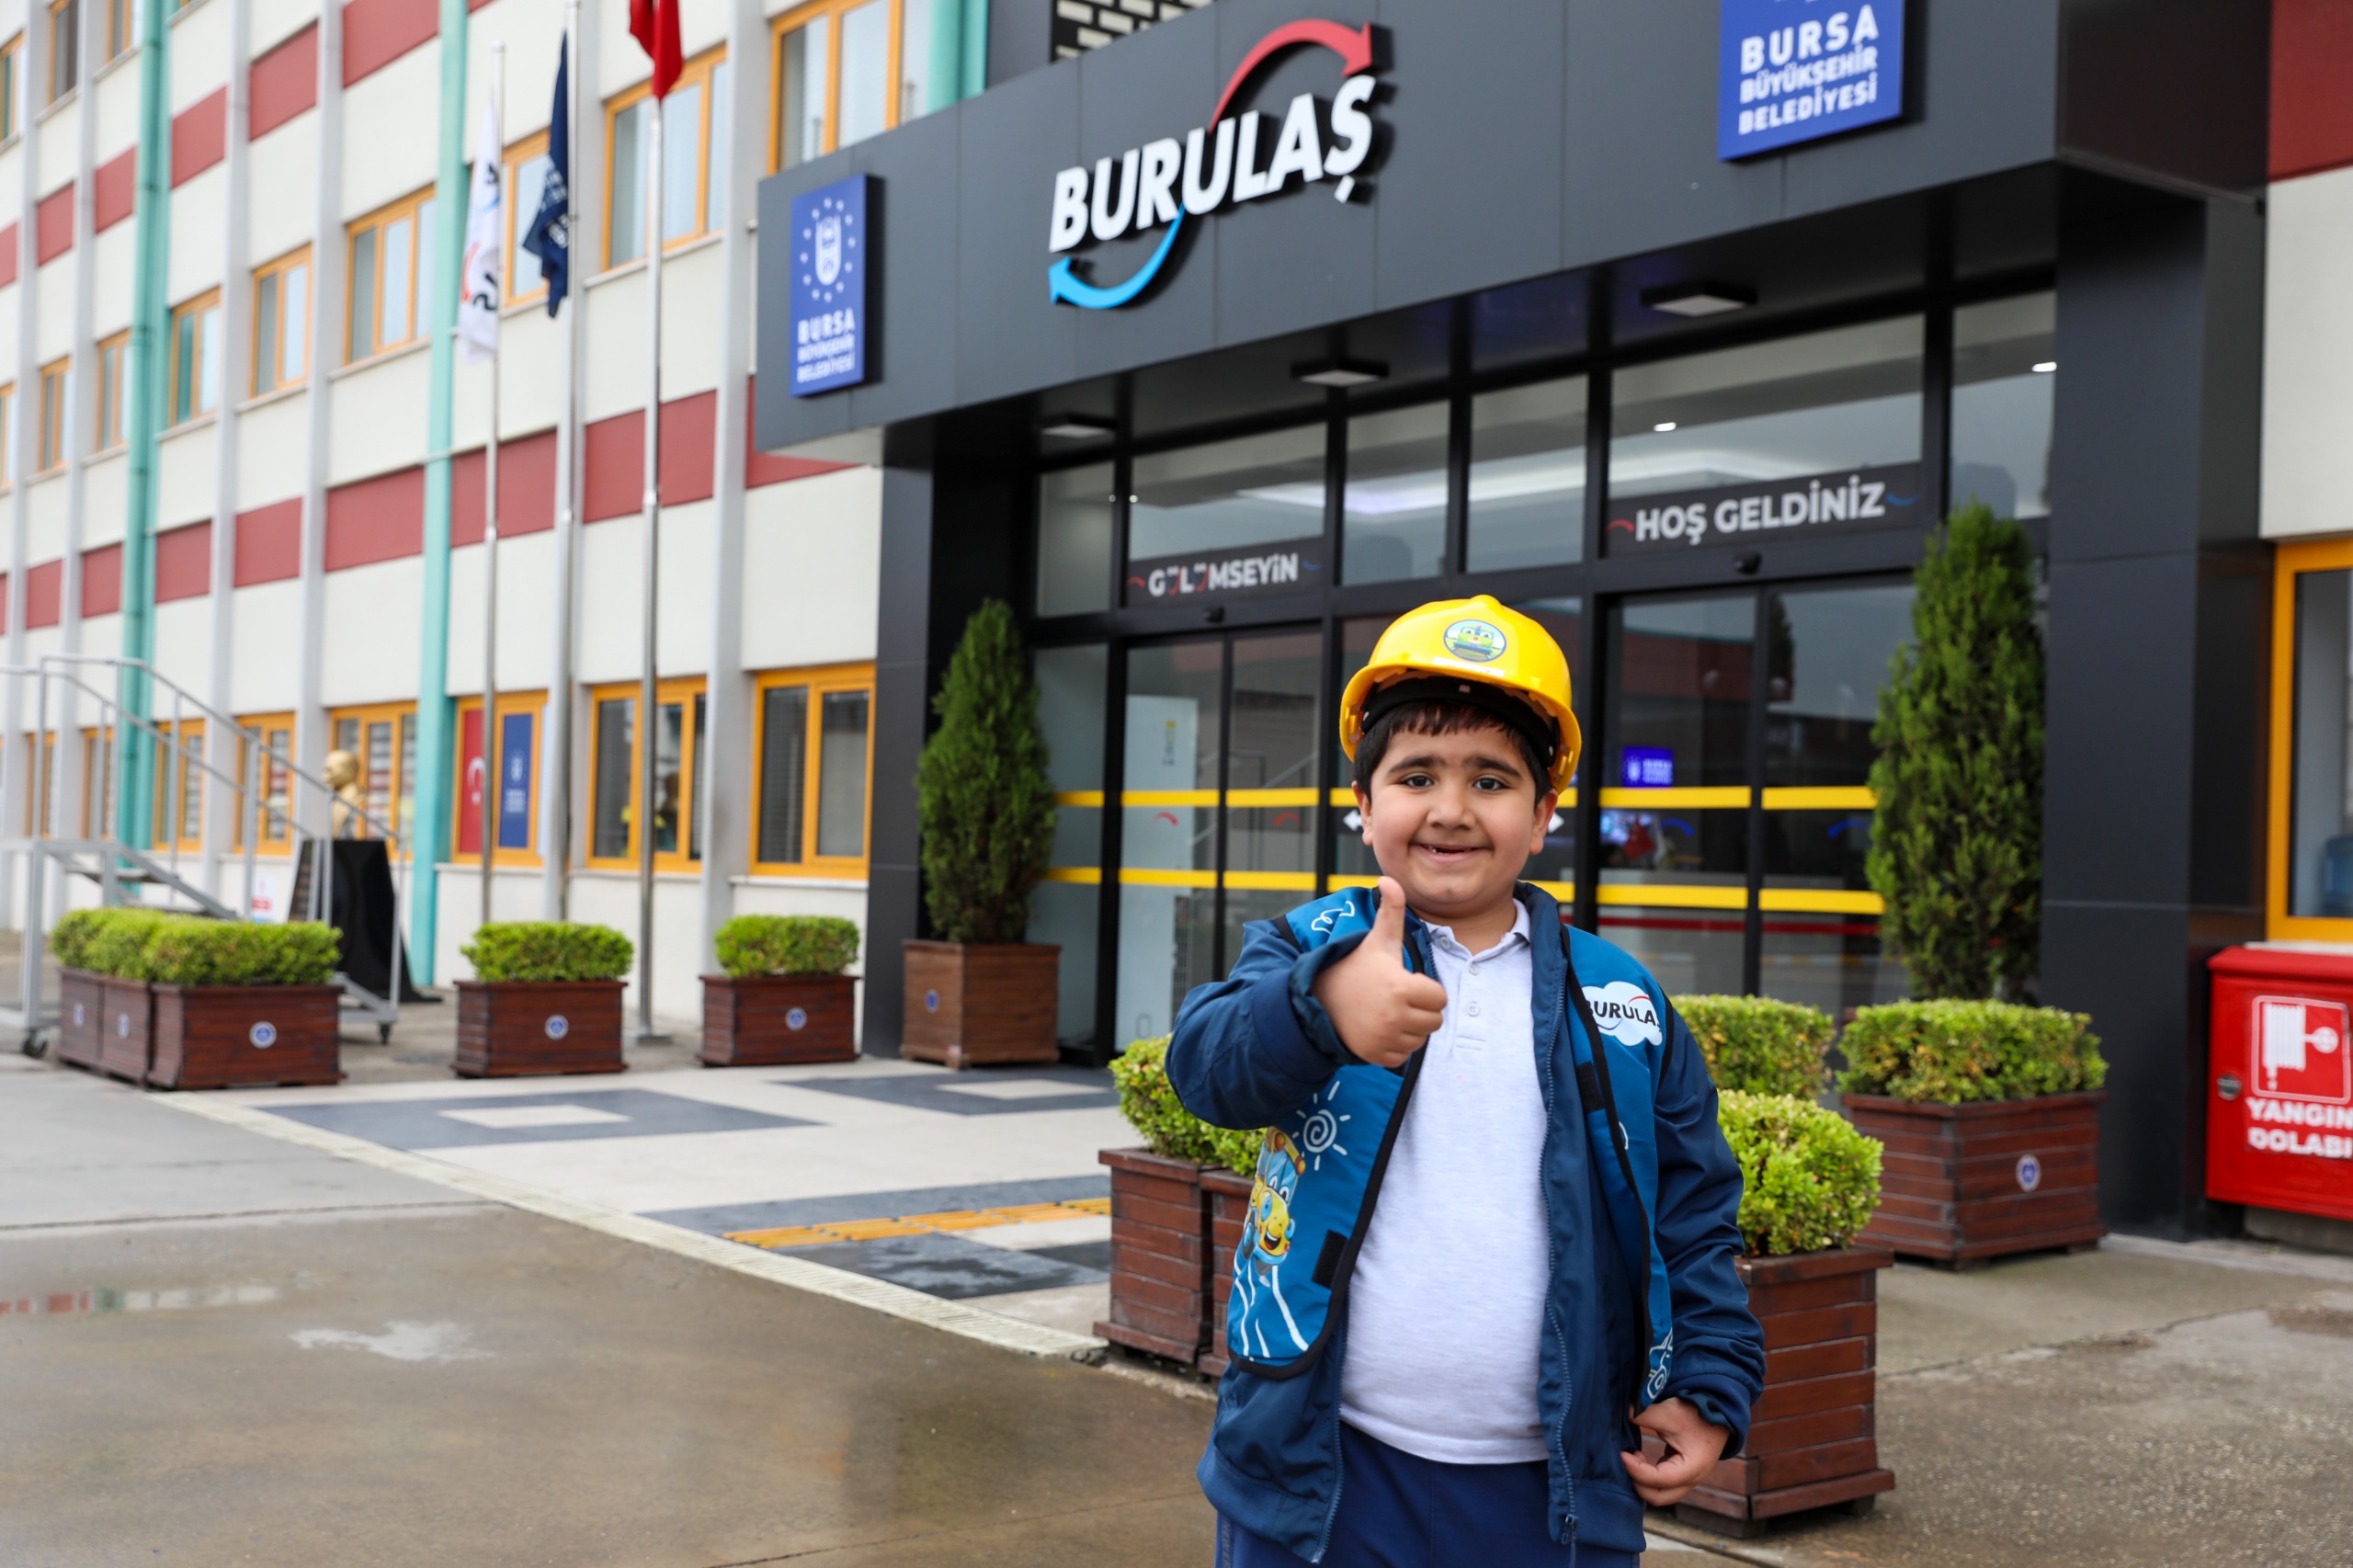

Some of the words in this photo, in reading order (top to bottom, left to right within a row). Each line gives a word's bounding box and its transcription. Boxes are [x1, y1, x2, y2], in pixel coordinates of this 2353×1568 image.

[1740, 4, 1880, 75] BURSA
[1737, 71, 1879, 136] BELEDİYESİ
[1739, 43, 1879, 105] BÜYÜKŞEHİR
[1048, 74, 1377, 255] BURULAŞ
[797, 306, 856, 346] BURSA
[1635, 504, 1708, 546] HOŞ
[1713, 474, 1886, 534] GELDİNİZ
[1586, 998, 1662, 1033] URULA
[2245, 1096, 2353, 1131] YANGIN
[2247, 1127, 2353, 1160] DOLABI
